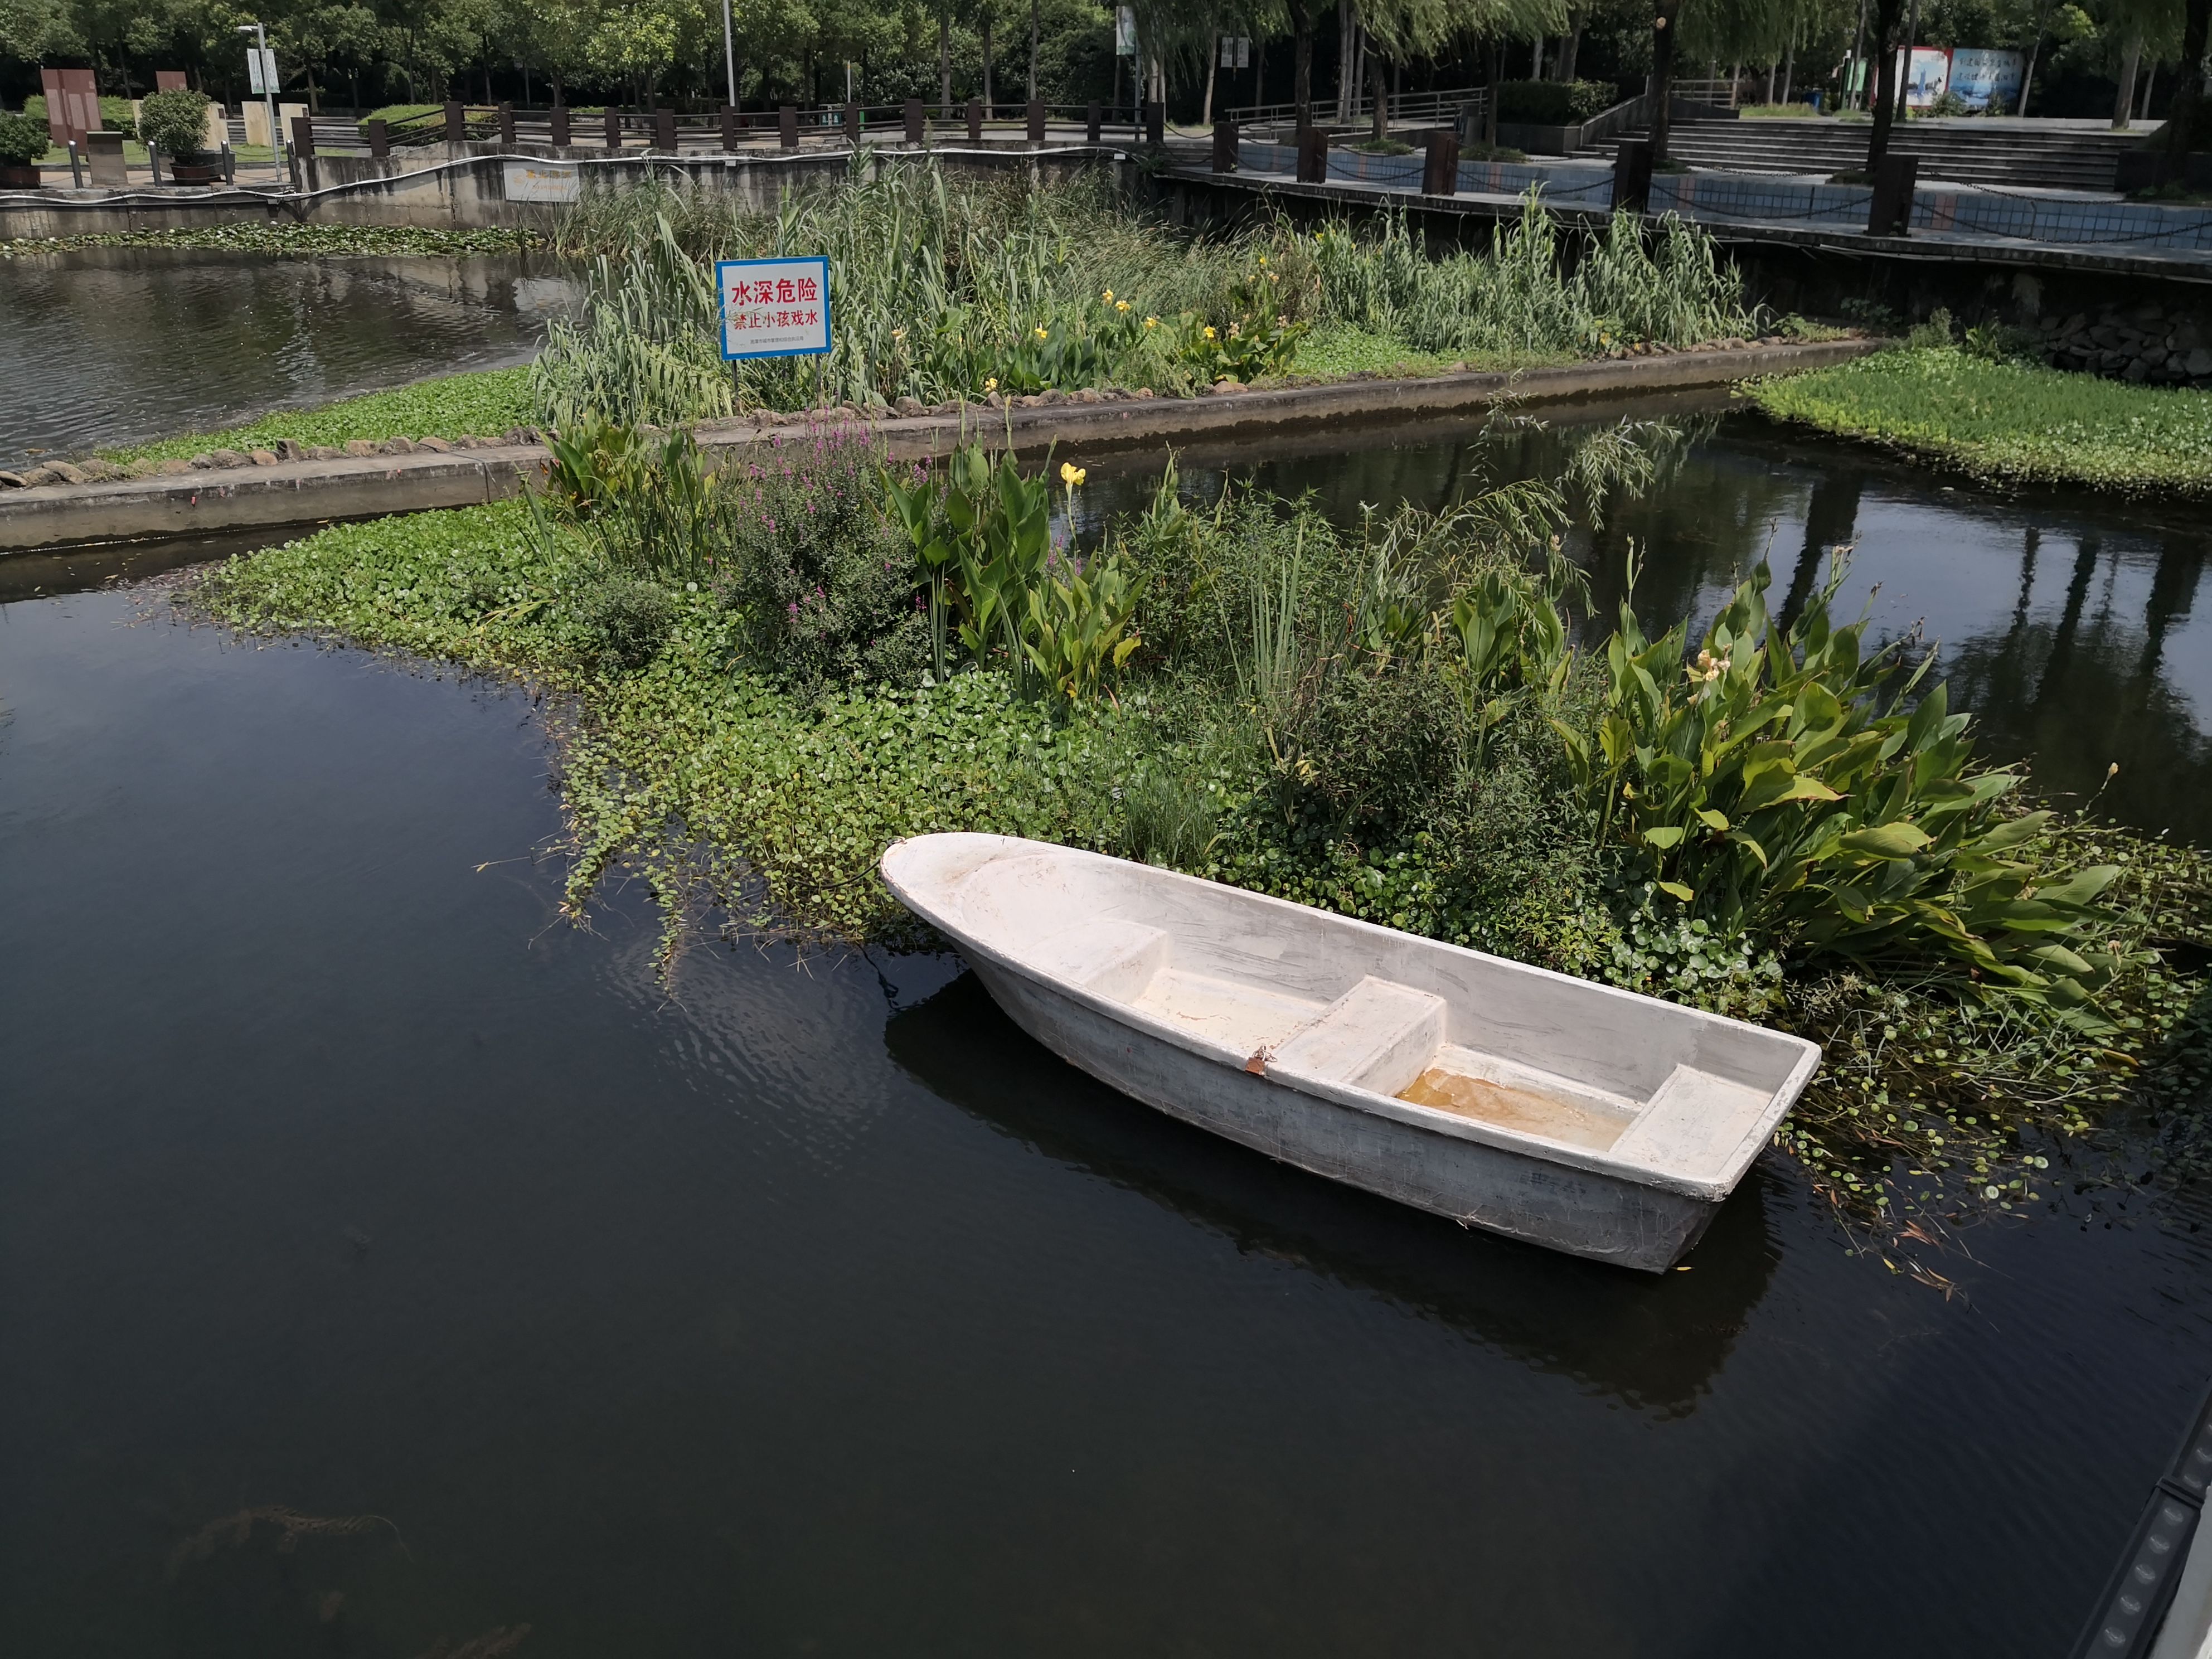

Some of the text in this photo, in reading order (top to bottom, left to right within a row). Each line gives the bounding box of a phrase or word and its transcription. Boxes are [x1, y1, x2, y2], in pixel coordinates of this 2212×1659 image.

[731, 277, 817, 305] 水深危险
[734, 309, 818, 330] 禁止小孩戏水
